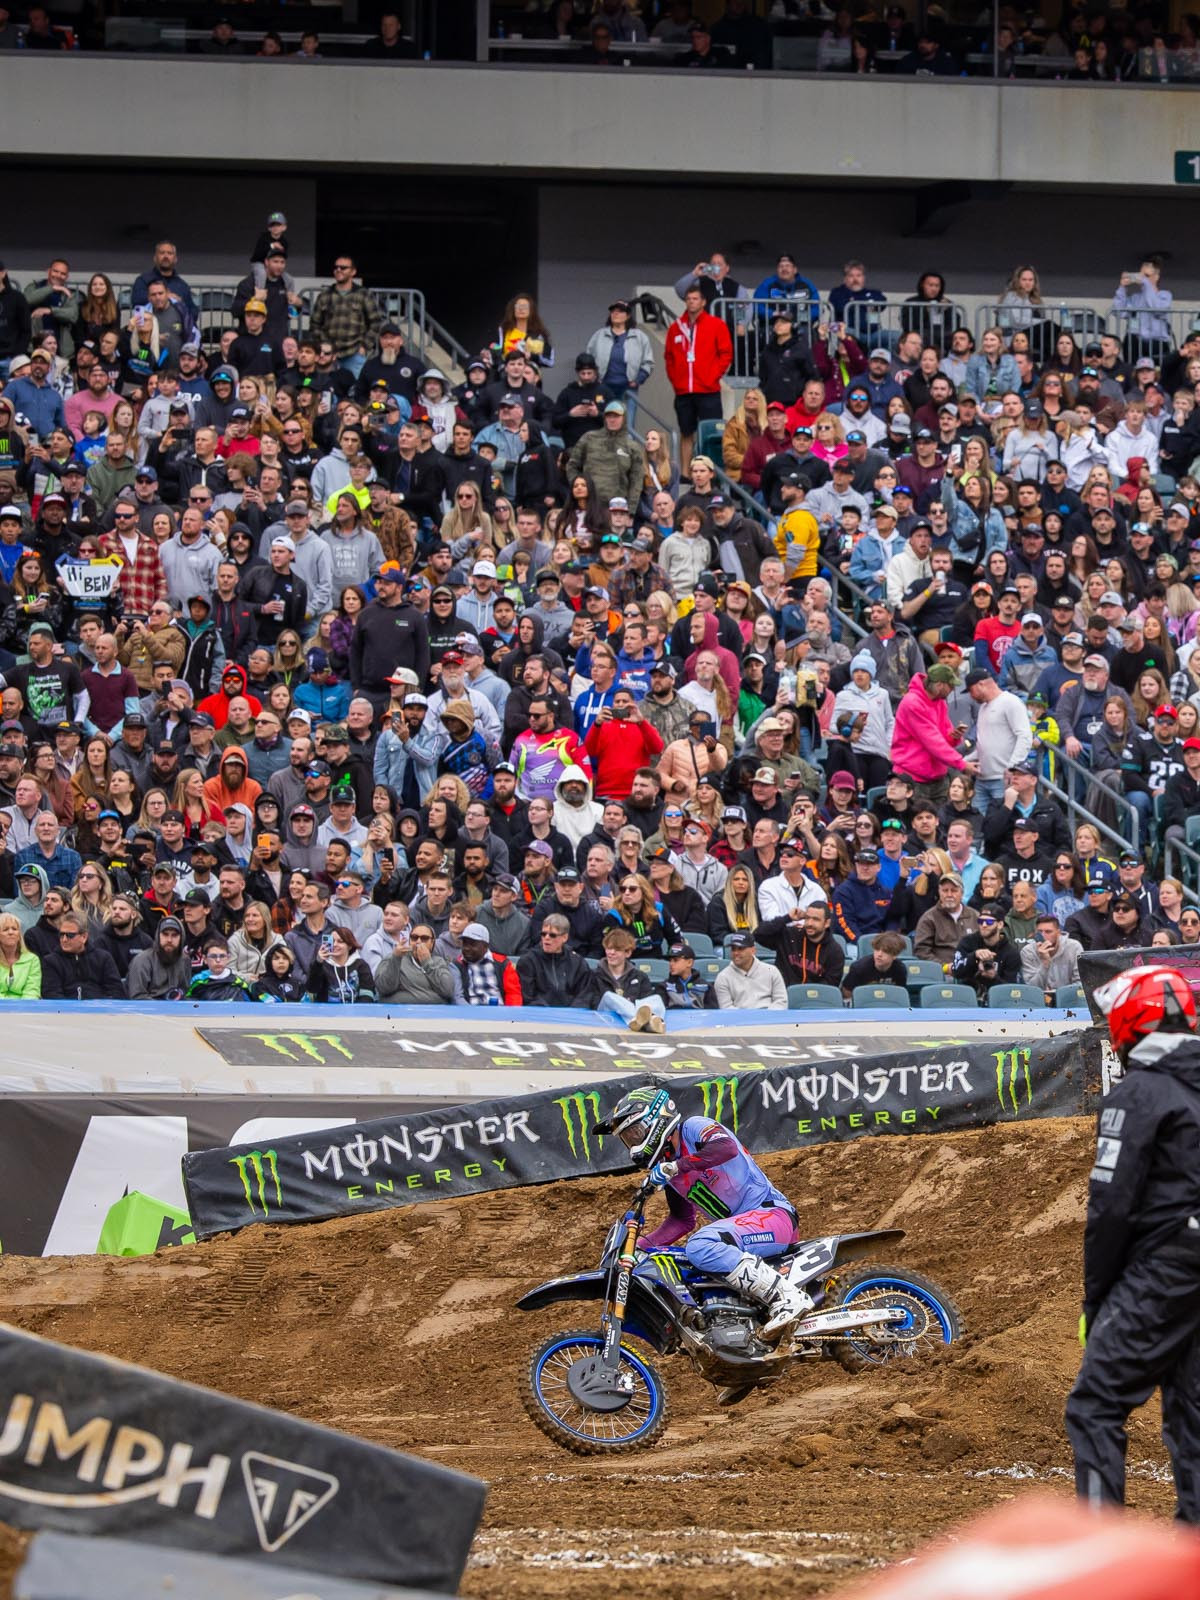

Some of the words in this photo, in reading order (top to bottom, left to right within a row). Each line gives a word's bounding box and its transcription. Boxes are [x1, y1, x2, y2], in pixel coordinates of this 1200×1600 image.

[67, 567, 83, 582] Hi
[84, 576, 110, 593] BEN
[1008, 868, 1043, 883] FOX
[391, 1037, 864, 1059] MONSTER
[491, 1056, 766, 1070] ENERG
[761, 1060, 973, 1112] MONSTER
[798, 1105, 941, 1134] ENERGY
[301, 1110, 540, 1181] MONSTER
[347, 1158, 507, 1200] ENERGY
[749, 1233, 774, 1243] YAMAHA
[800, 1244, 833, 1272] 3
[620, 1340, 650, 1367] DUNLOP
